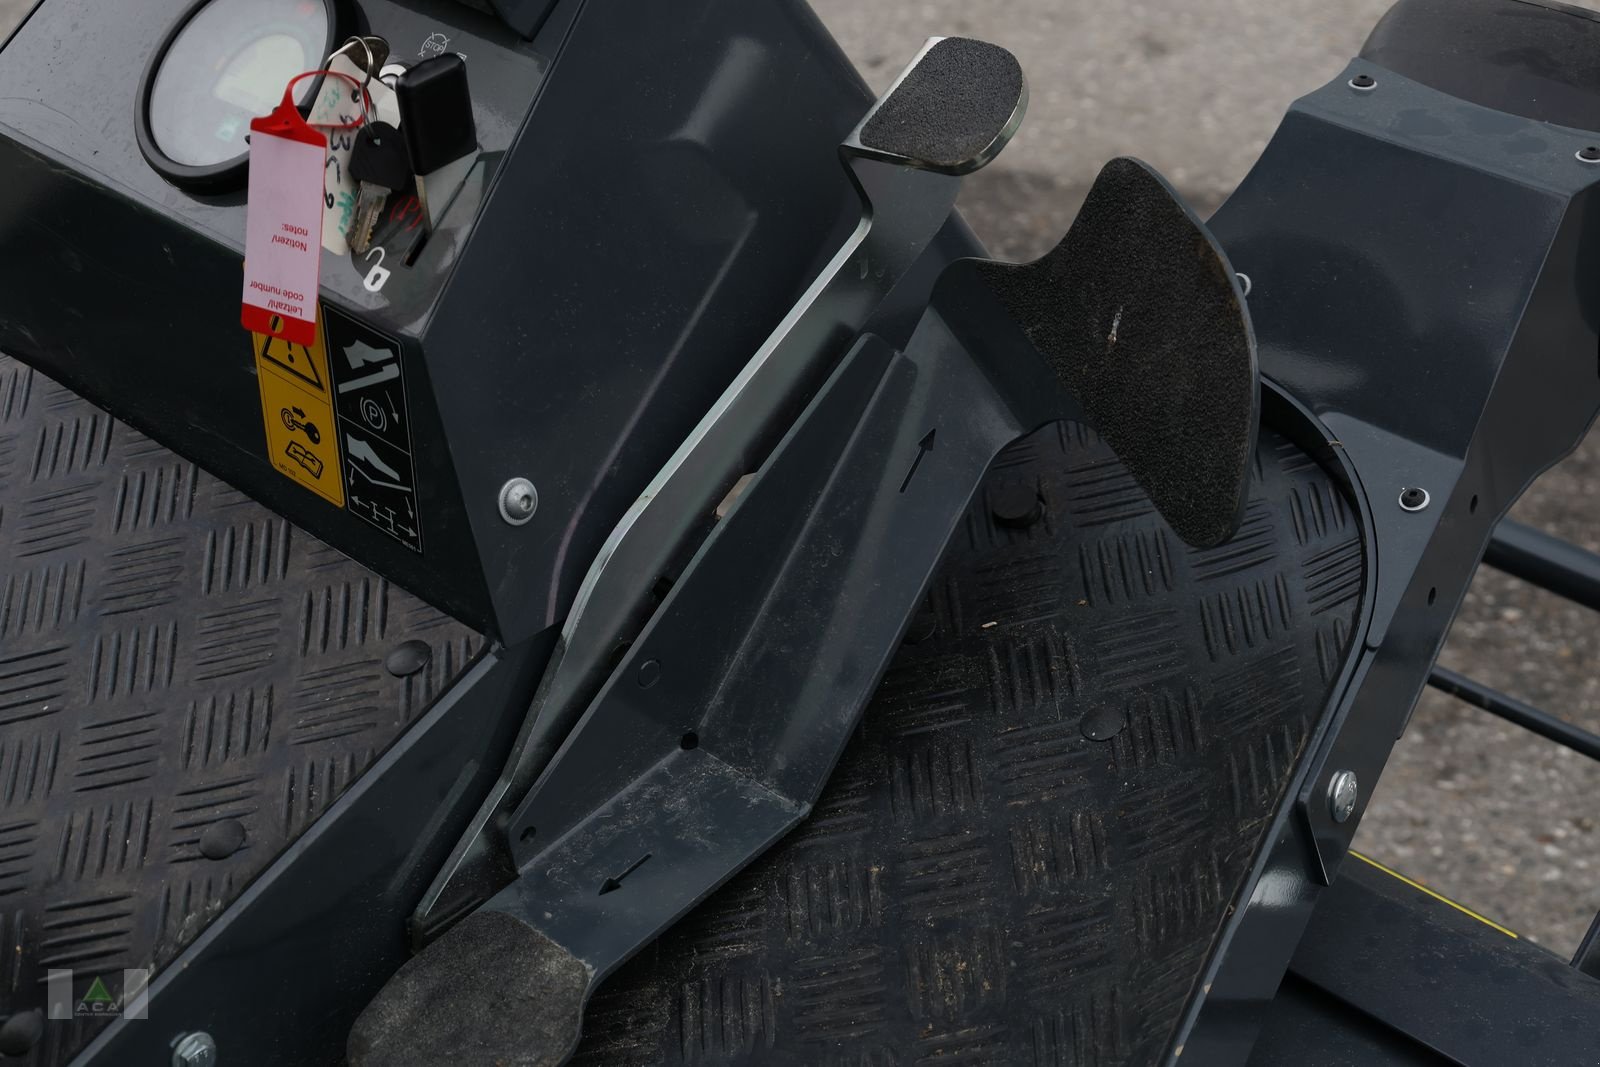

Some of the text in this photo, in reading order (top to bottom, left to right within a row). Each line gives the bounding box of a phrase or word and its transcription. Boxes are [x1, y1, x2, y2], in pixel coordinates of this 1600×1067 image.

[425, 40, 444, 52] STOP
[281, 223, 309, 237] notes:
[271, 234, 307, 252] Notizen/
[250, 280, 304, 302] code number
[267, 299, 303, 317] Leitzahl/
